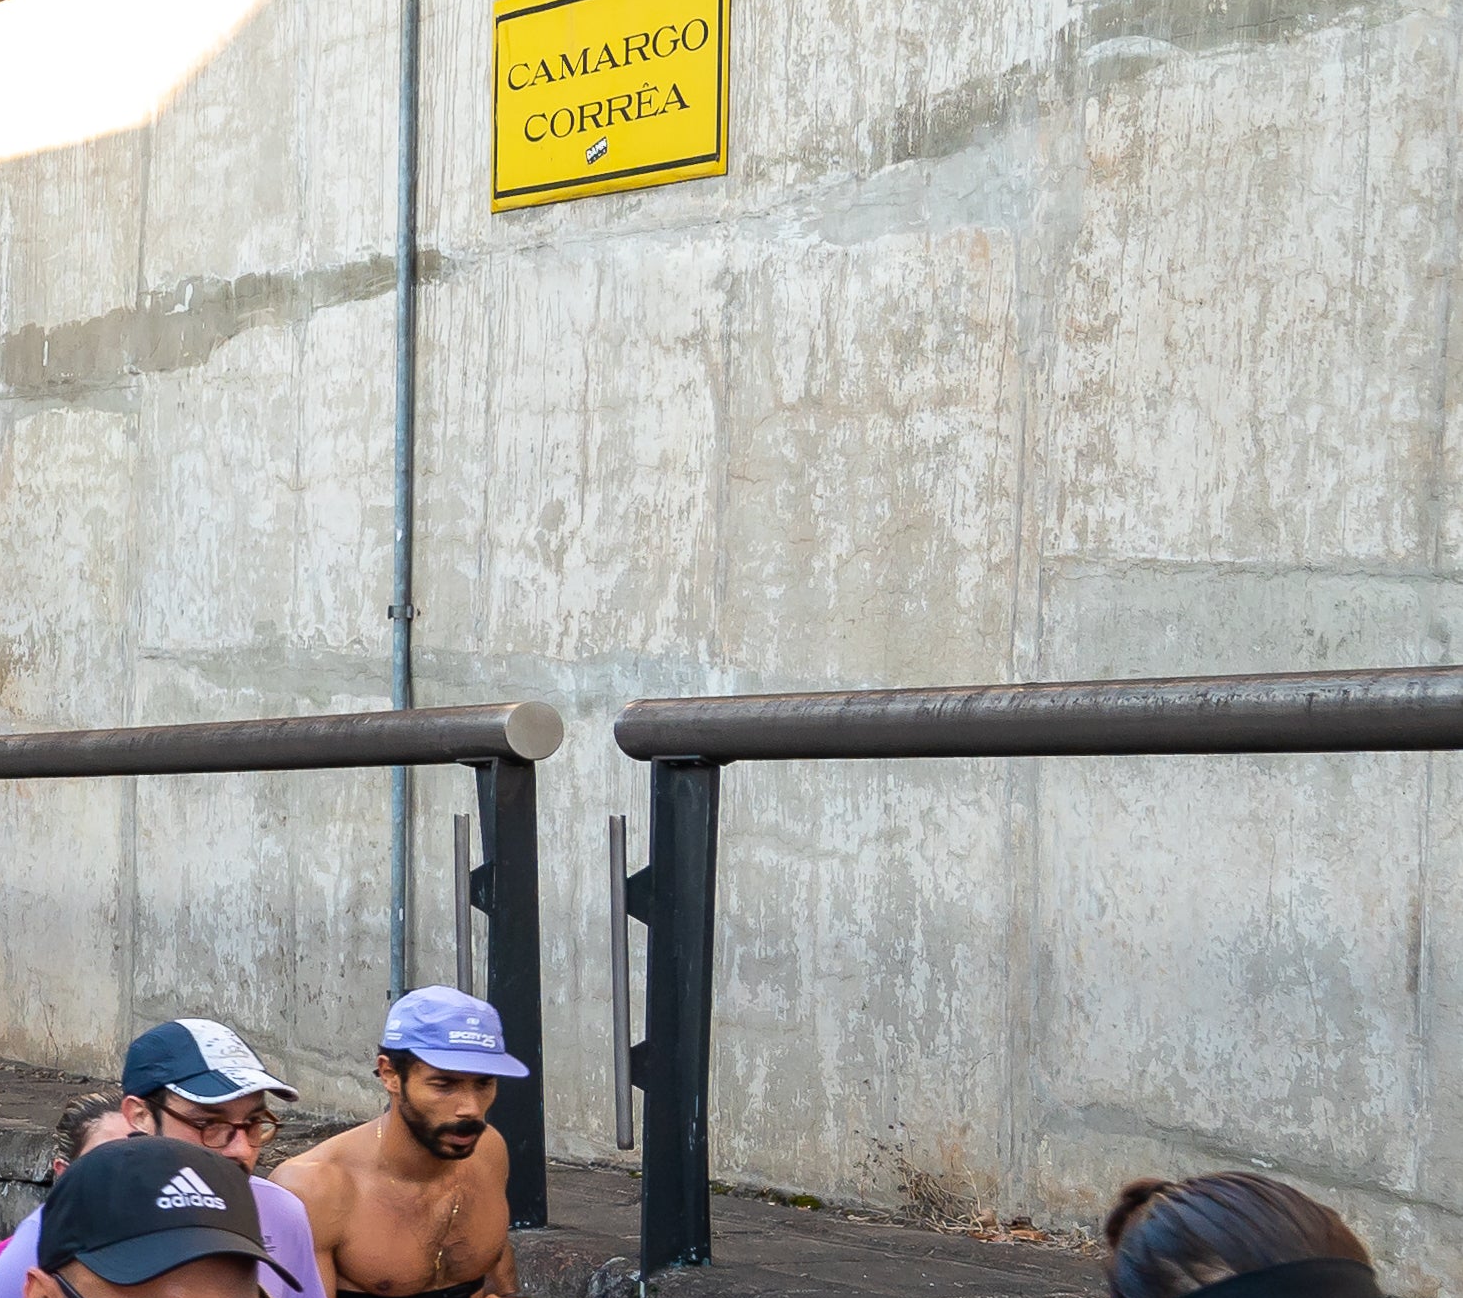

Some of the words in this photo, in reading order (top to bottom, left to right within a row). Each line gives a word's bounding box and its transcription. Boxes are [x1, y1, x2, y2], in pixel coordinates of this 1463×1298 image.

[507, 19, 709, 90] CAMARGO
[524, 82, 690, 142] CORRÊA
[156, 1192, 227, 1211] adidas
